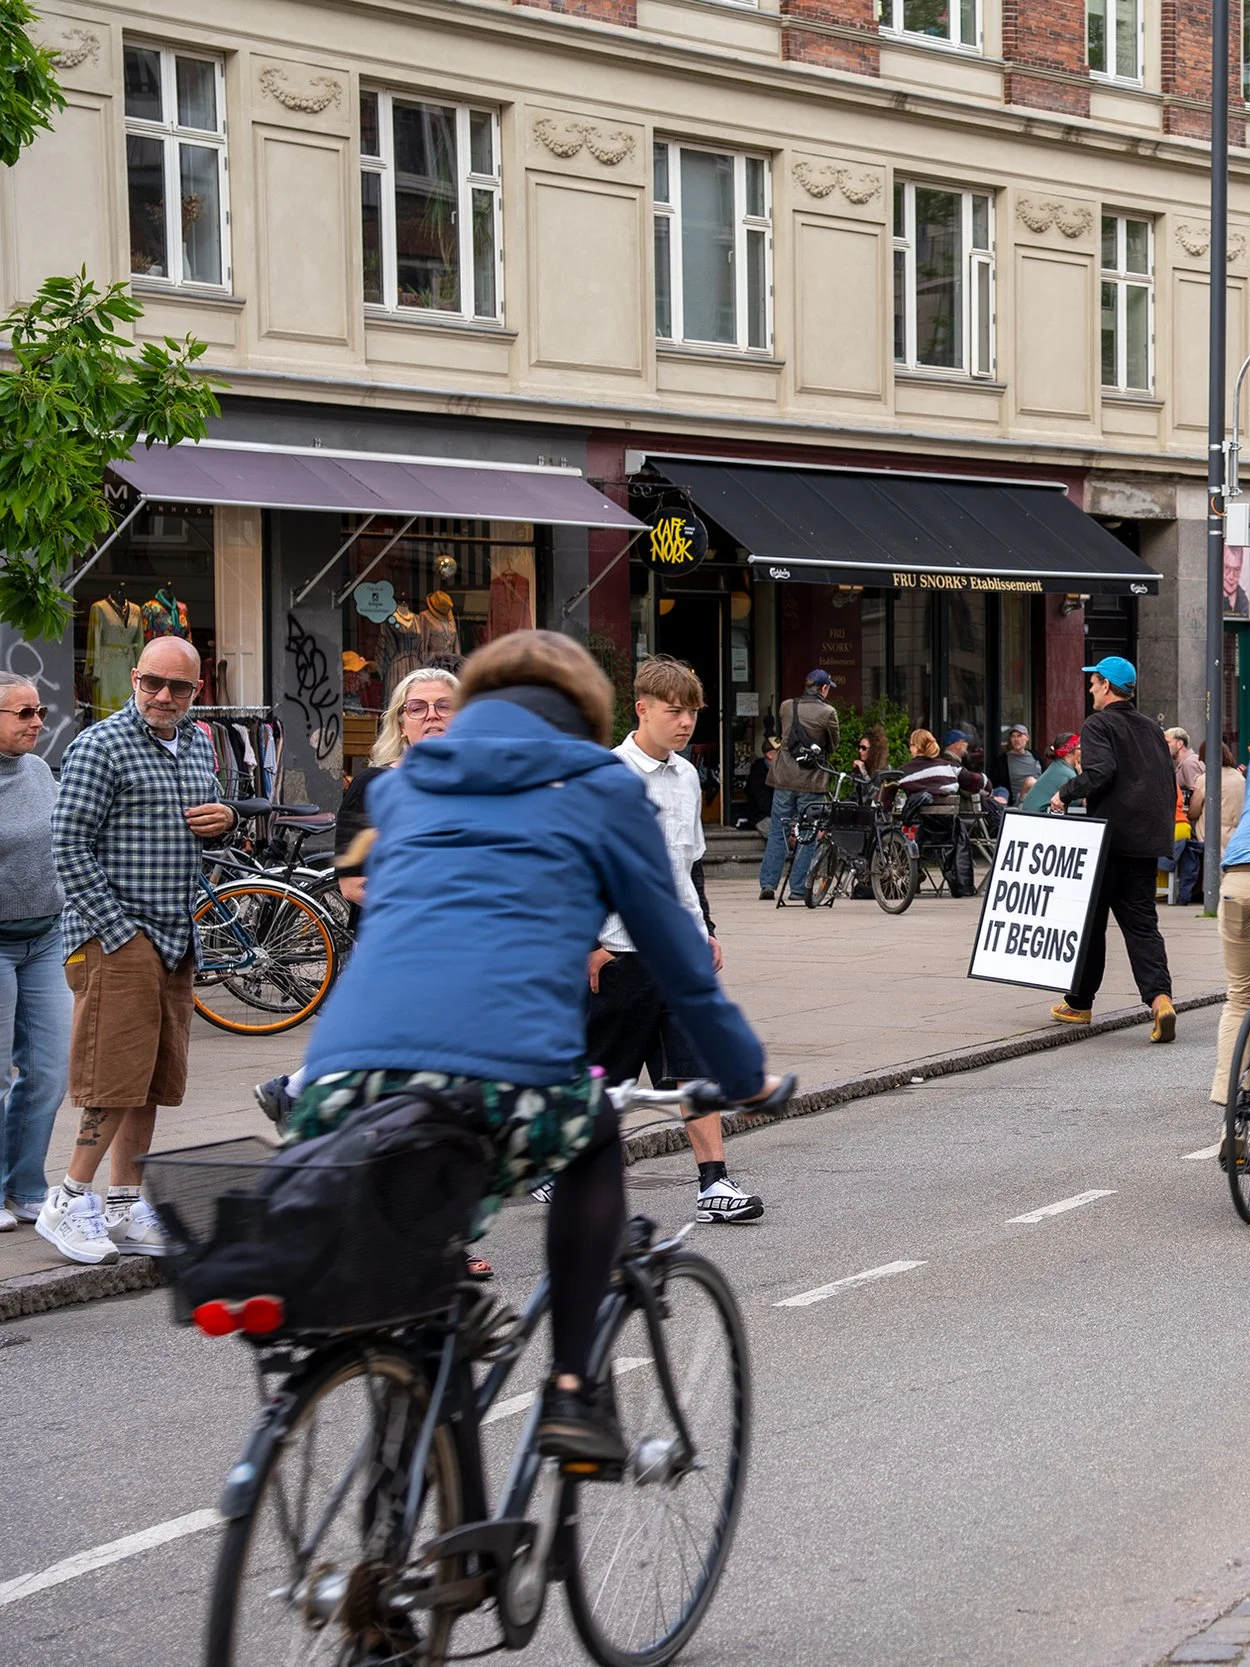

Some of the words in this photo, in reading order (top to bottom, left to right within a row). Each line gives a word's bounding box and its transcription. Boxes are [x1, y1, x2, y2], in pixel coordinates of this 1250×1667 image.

[892, 573, 917, 588] FRU
[969, 576, 1043, 592] Etablissement
[1000, 840, 1029, 873] AT
[1028, 843, 1088, 880] SOME
[992, 880, 1054, 917] POINT
[983, 920, 1005, 952] IT
[1005, 922, 1078, 963] BEGINS
